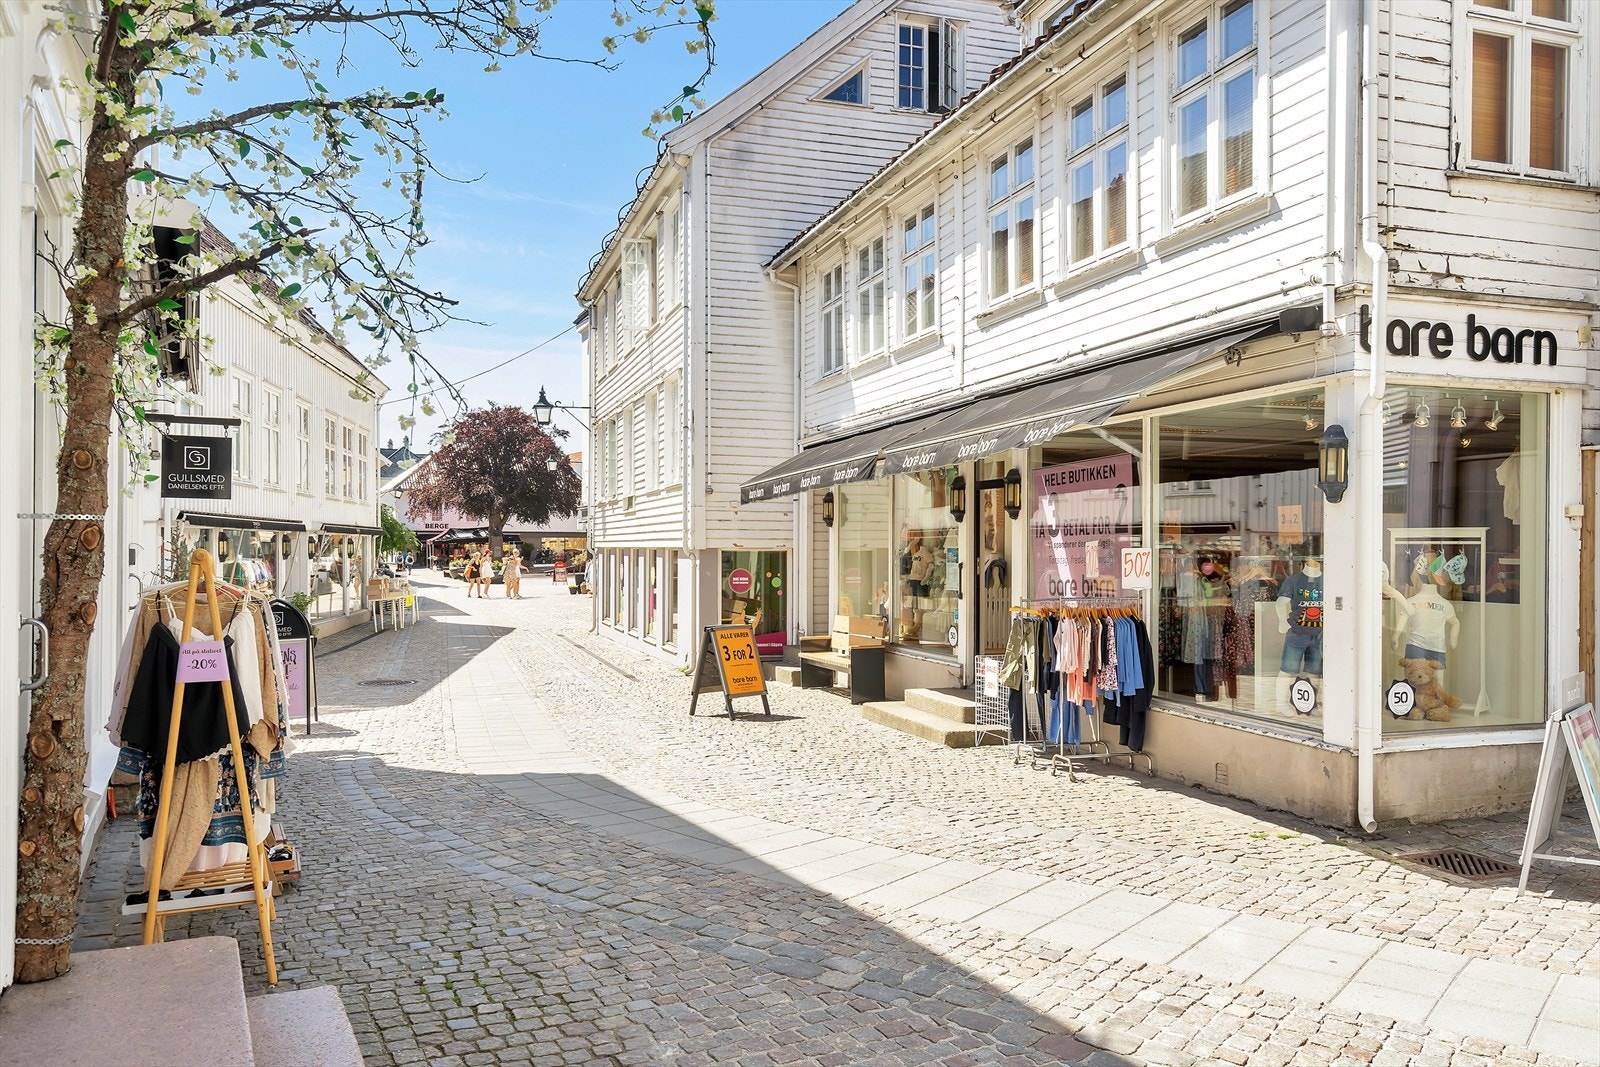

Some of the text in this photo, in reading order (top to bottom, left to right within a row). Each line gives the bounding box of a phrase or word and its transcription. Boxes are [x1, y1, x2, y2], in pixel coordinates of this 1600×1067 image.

[1467, 313, 1558, 366] barn
[957, 438, 998, 458] bare barn
[902, 451, 936, 468] bare barn
[168, 473, 226, 484] GULLSMED
[833, 466, 859, 481] bare barn
[1044, 464, 1116, 487] HELE BUTIKKEN
[1063, 517, 1090, 537] BETAL
[1092, 515, 1111, 535] FOR
[1124, 551, 1151, 578] 50%
[1049, 574, 1077, 597] bare
[722, 643, 754, 661] 3 FOR 2
[187, 659, 217, 670] -20%
[1297, 688, 1310, 702] 50
[1393, 691, 1409, 704] 50
